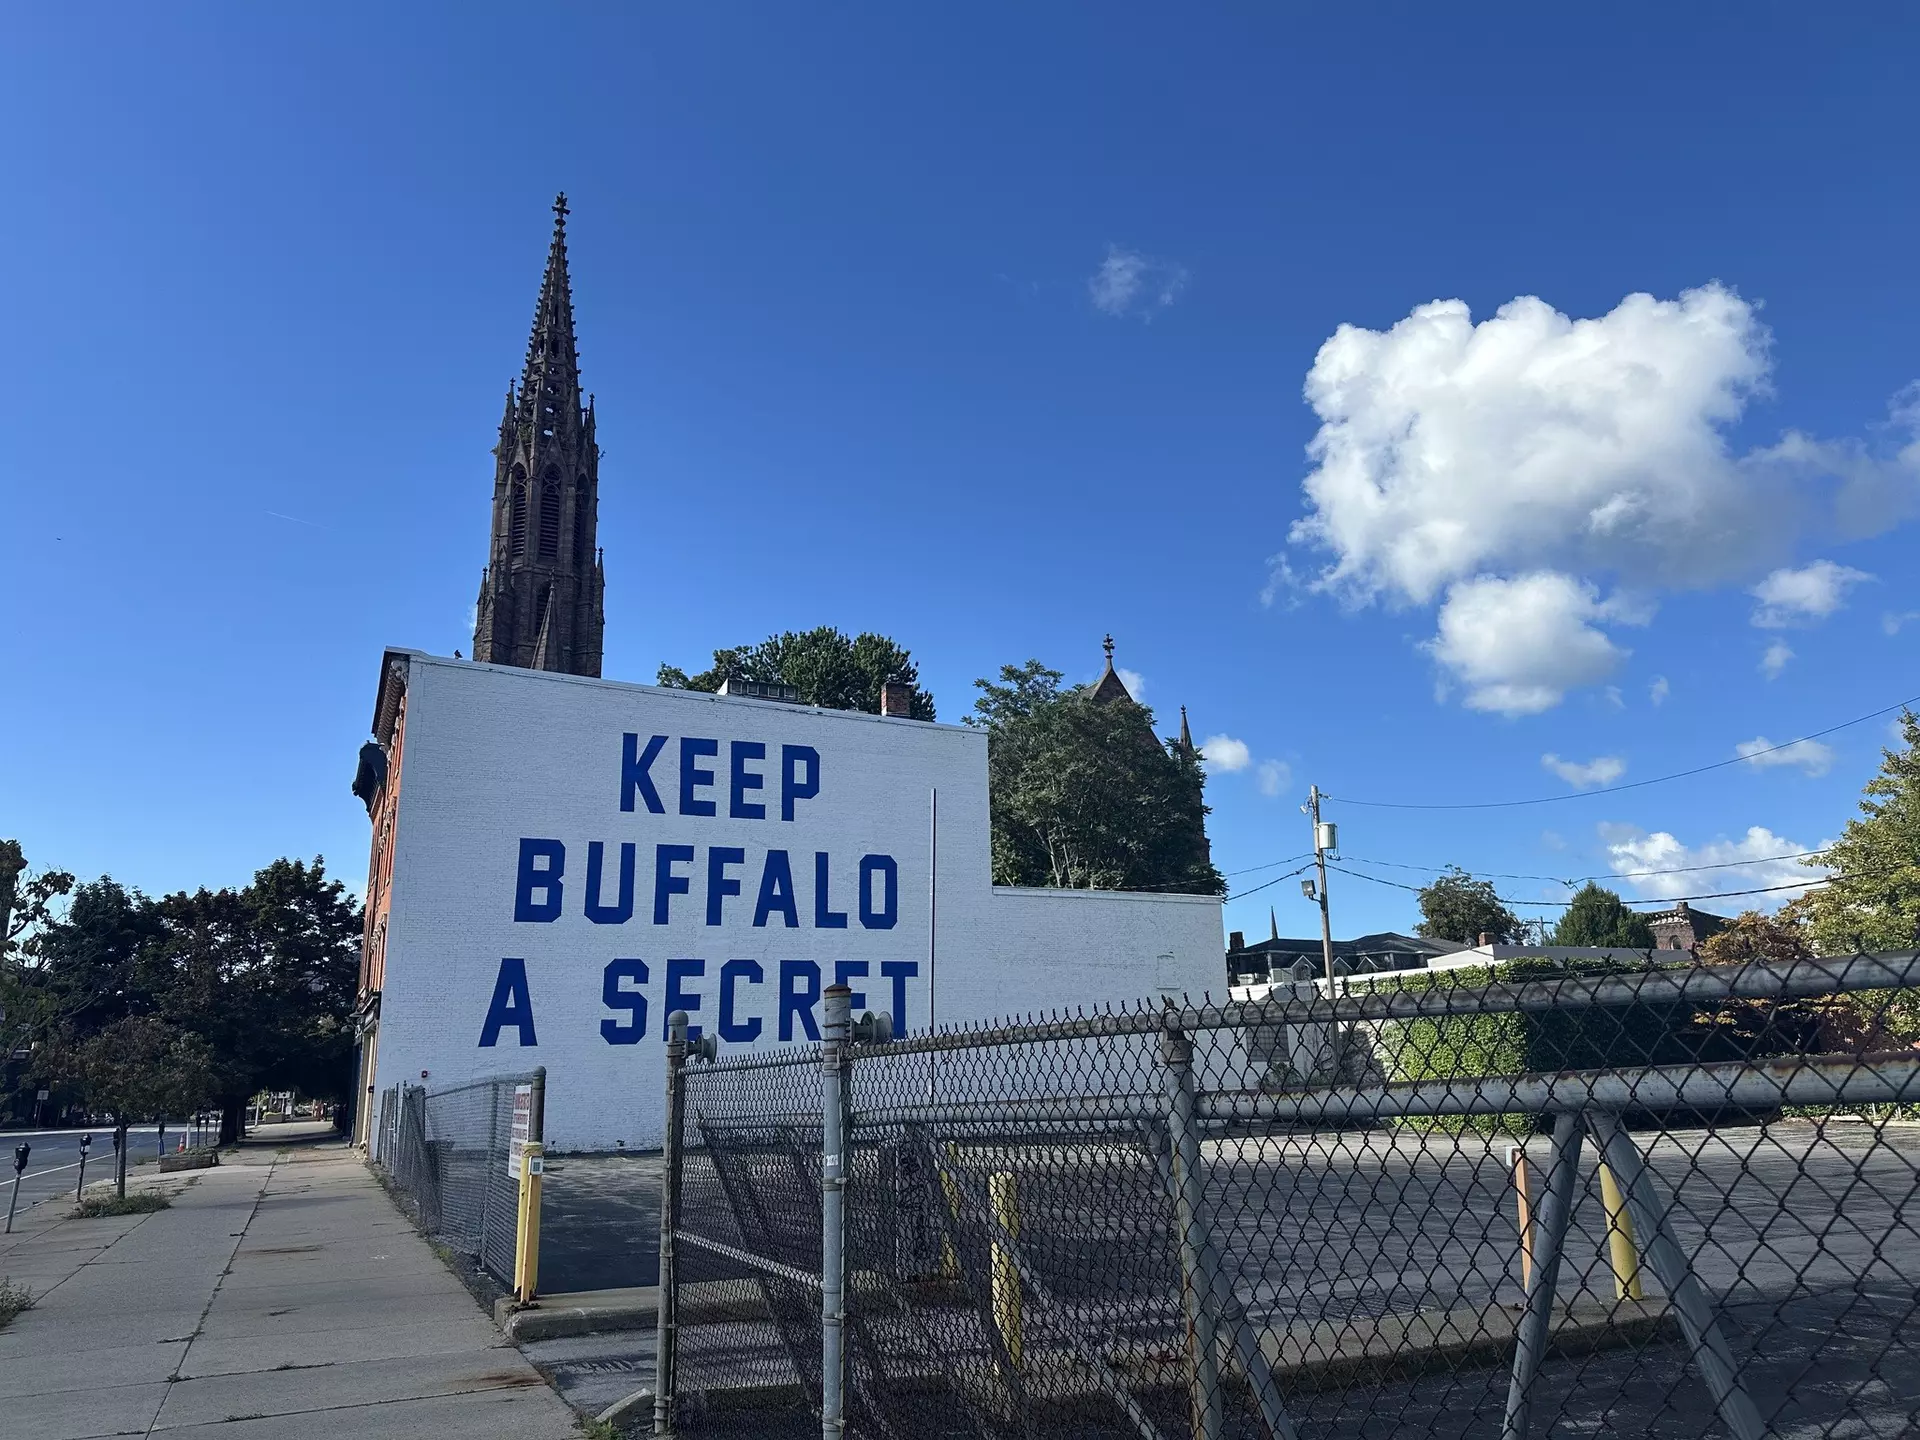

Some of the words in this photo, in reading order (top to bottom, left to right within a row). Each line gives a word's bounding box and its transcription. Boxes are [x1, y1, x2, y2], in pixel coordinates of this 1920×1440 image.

[620, 733, 820, 821] KEEP
[514, 838, 898, 930] BUFFALO
[478, 958, 537, 1047] A
